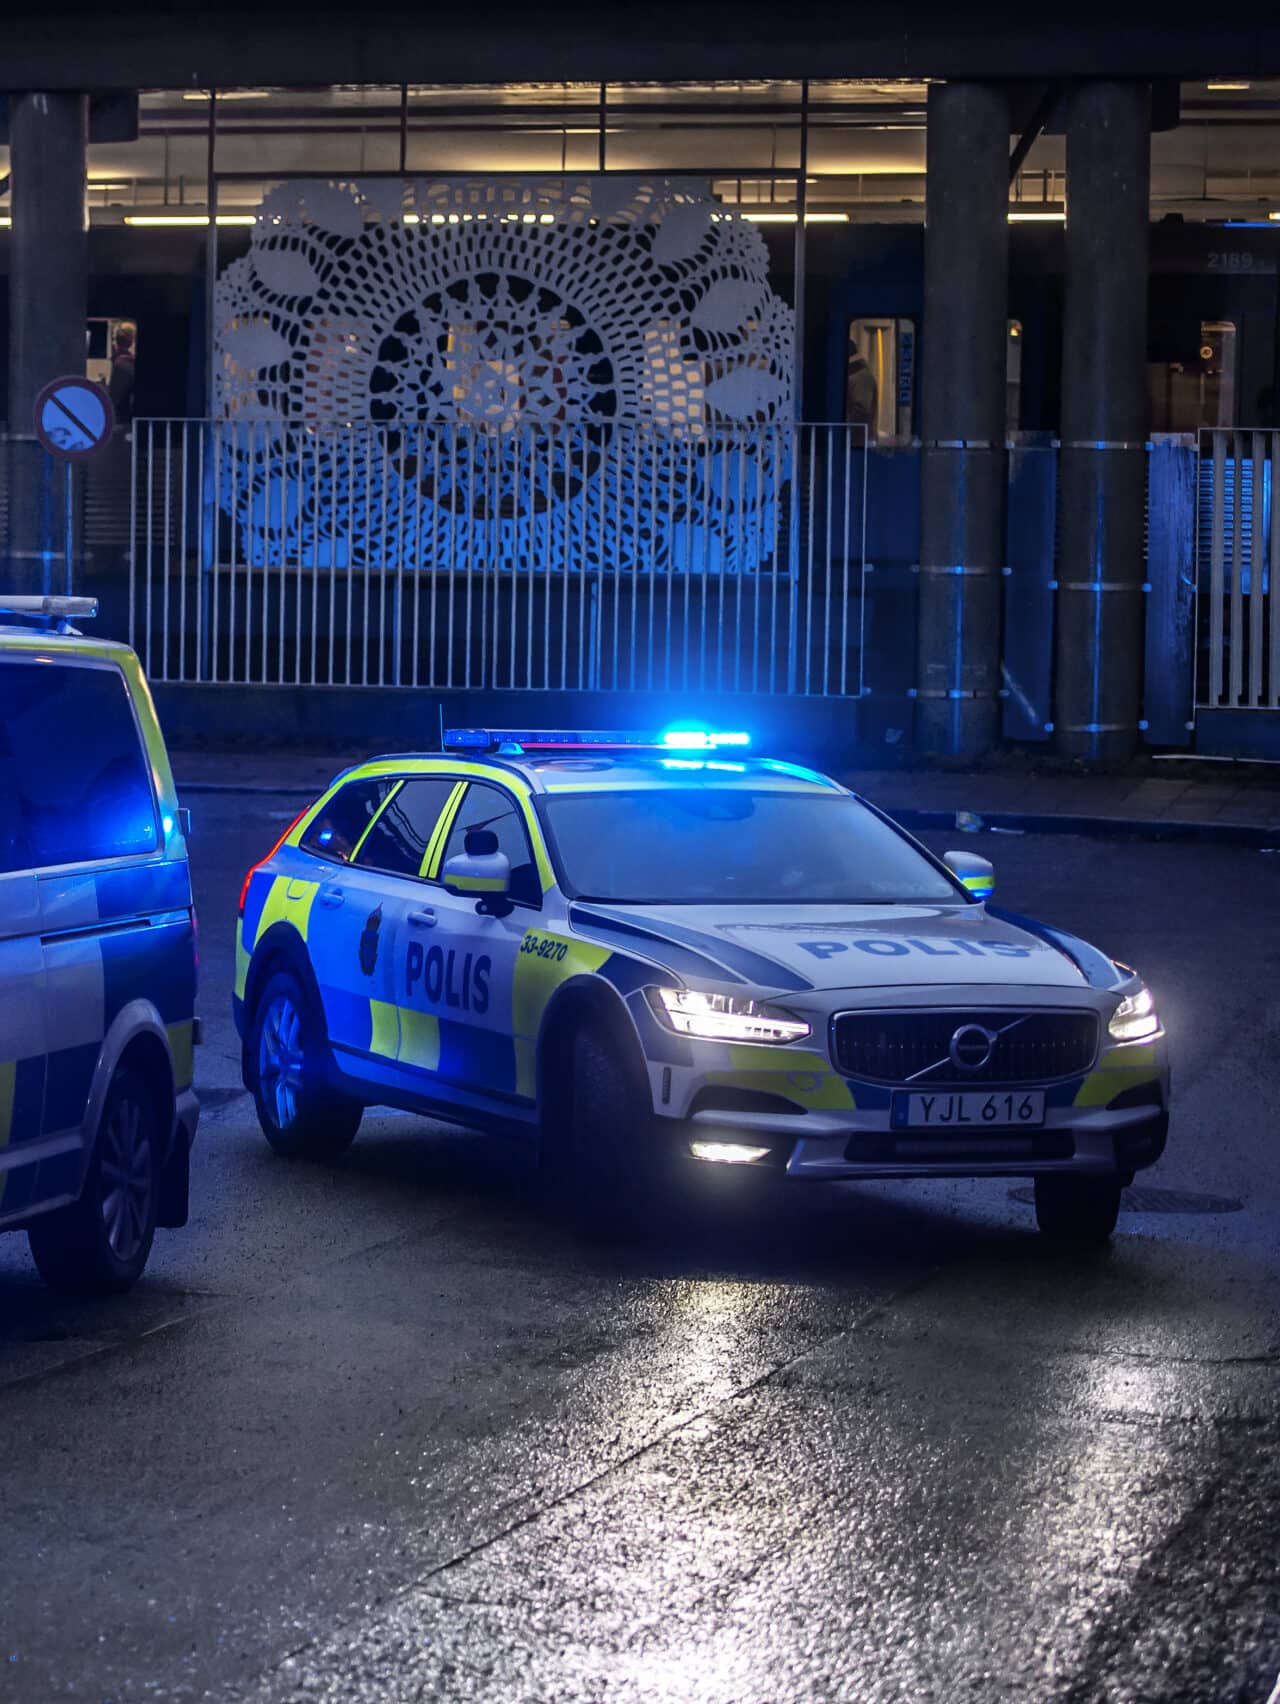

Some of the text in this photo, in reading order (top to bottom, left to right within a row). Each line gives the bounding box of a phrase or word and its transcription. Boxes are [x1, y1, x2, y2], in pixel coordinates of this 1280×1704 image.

[520, 934, 568, 961] 33-9270
[795, 939, 1031, 960] POLIS
[405, 940, 492, 1015] POLIS
[920, 1094, 1033, 1122] YJL 616
